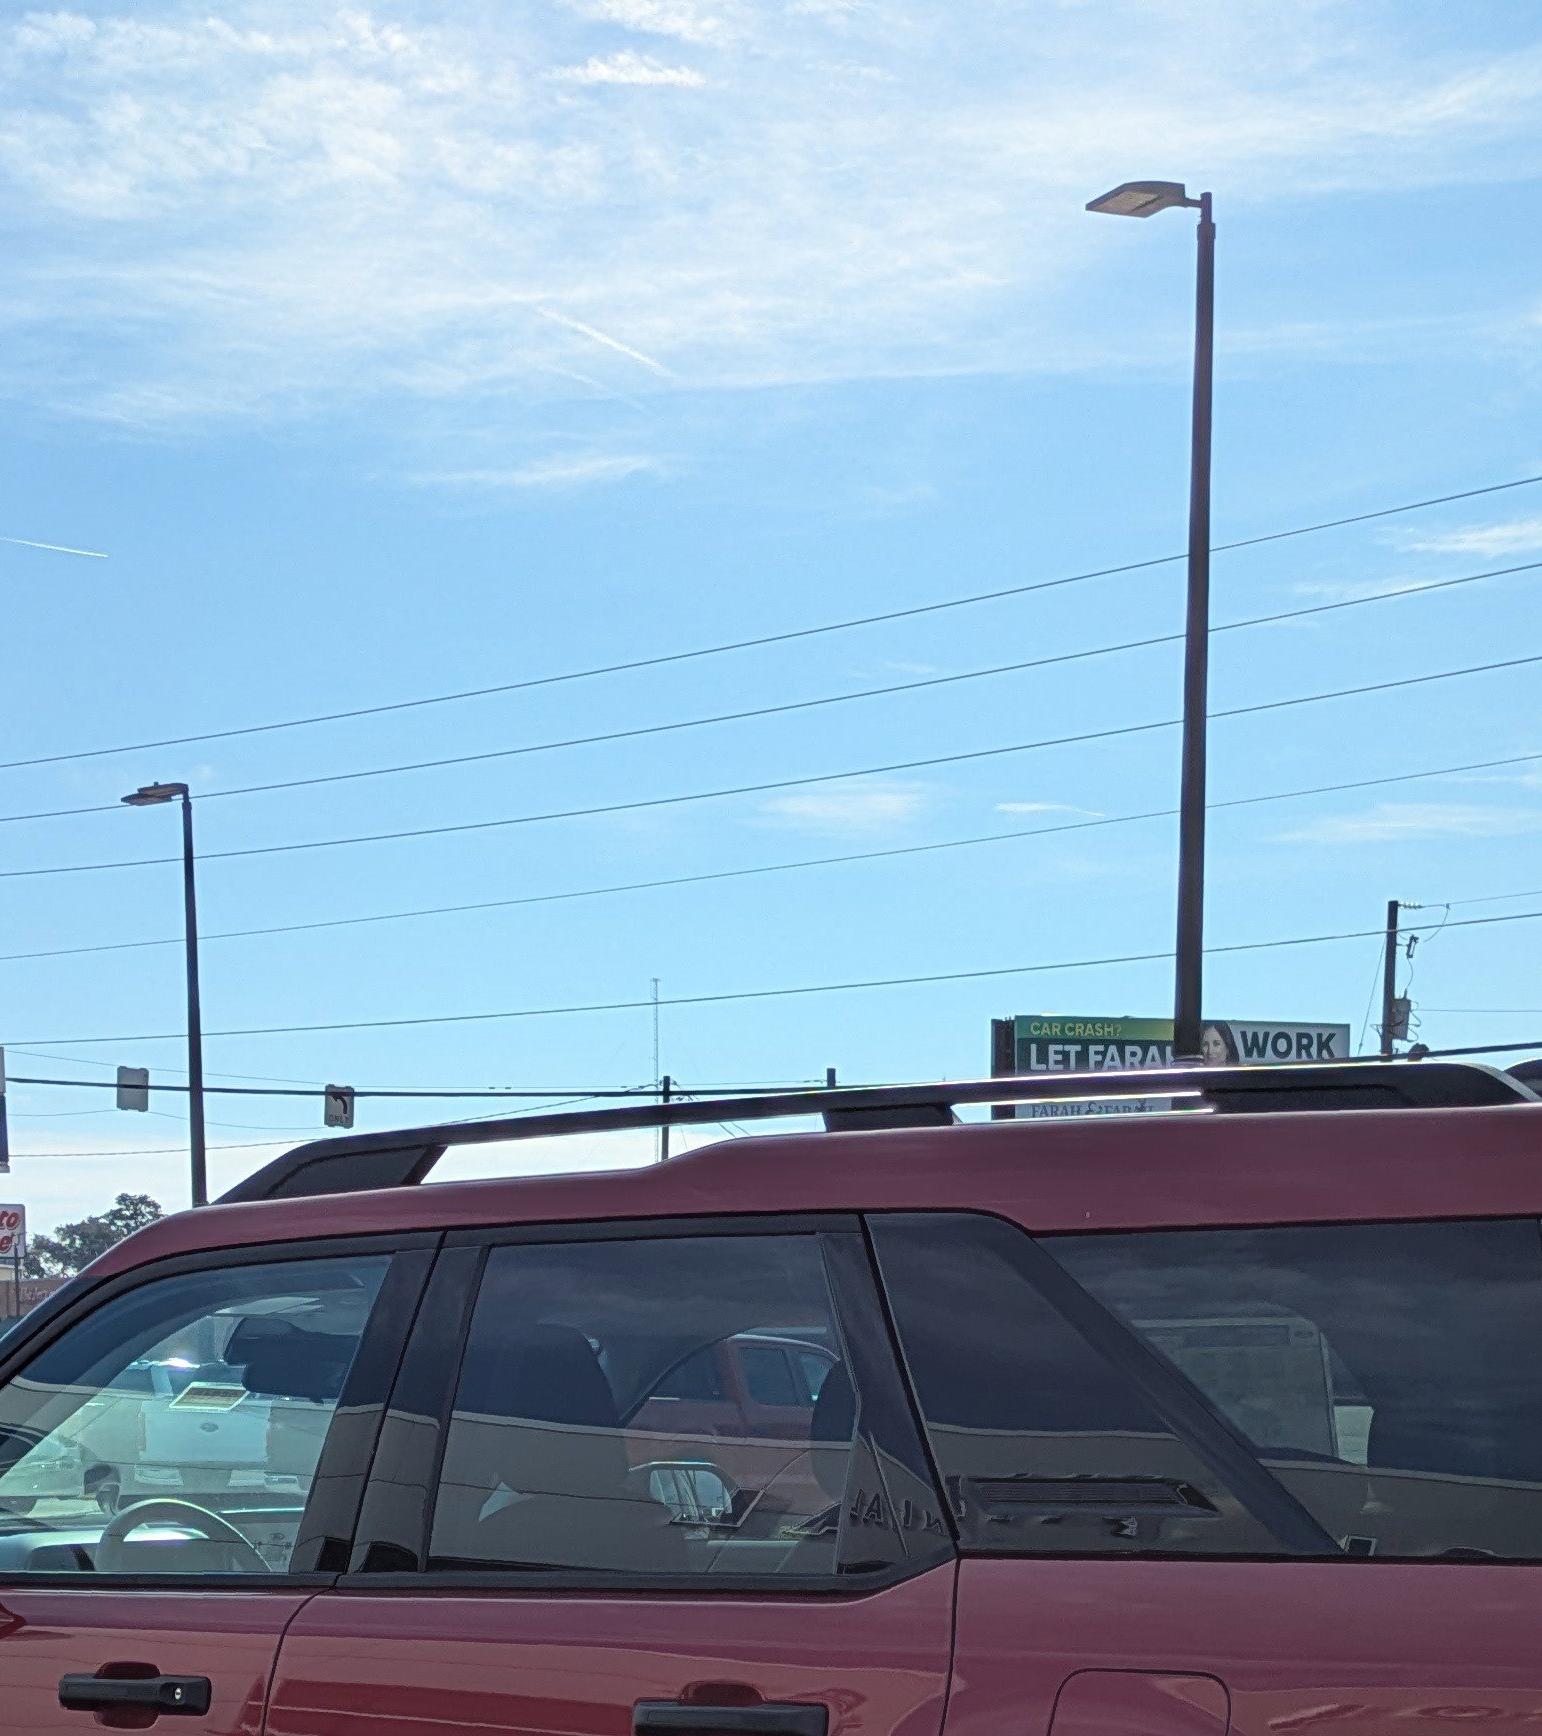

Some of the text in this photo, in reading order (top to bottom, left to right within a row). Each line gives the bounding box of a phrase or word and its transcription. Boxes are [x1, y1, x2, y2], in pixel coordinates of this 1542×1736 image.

[1030, 1022, 1122, 1037] CAR CRASH?
[1030, 1044, 1082, 1071] LET
[1240, 1030, 1337, 1060] WORK
